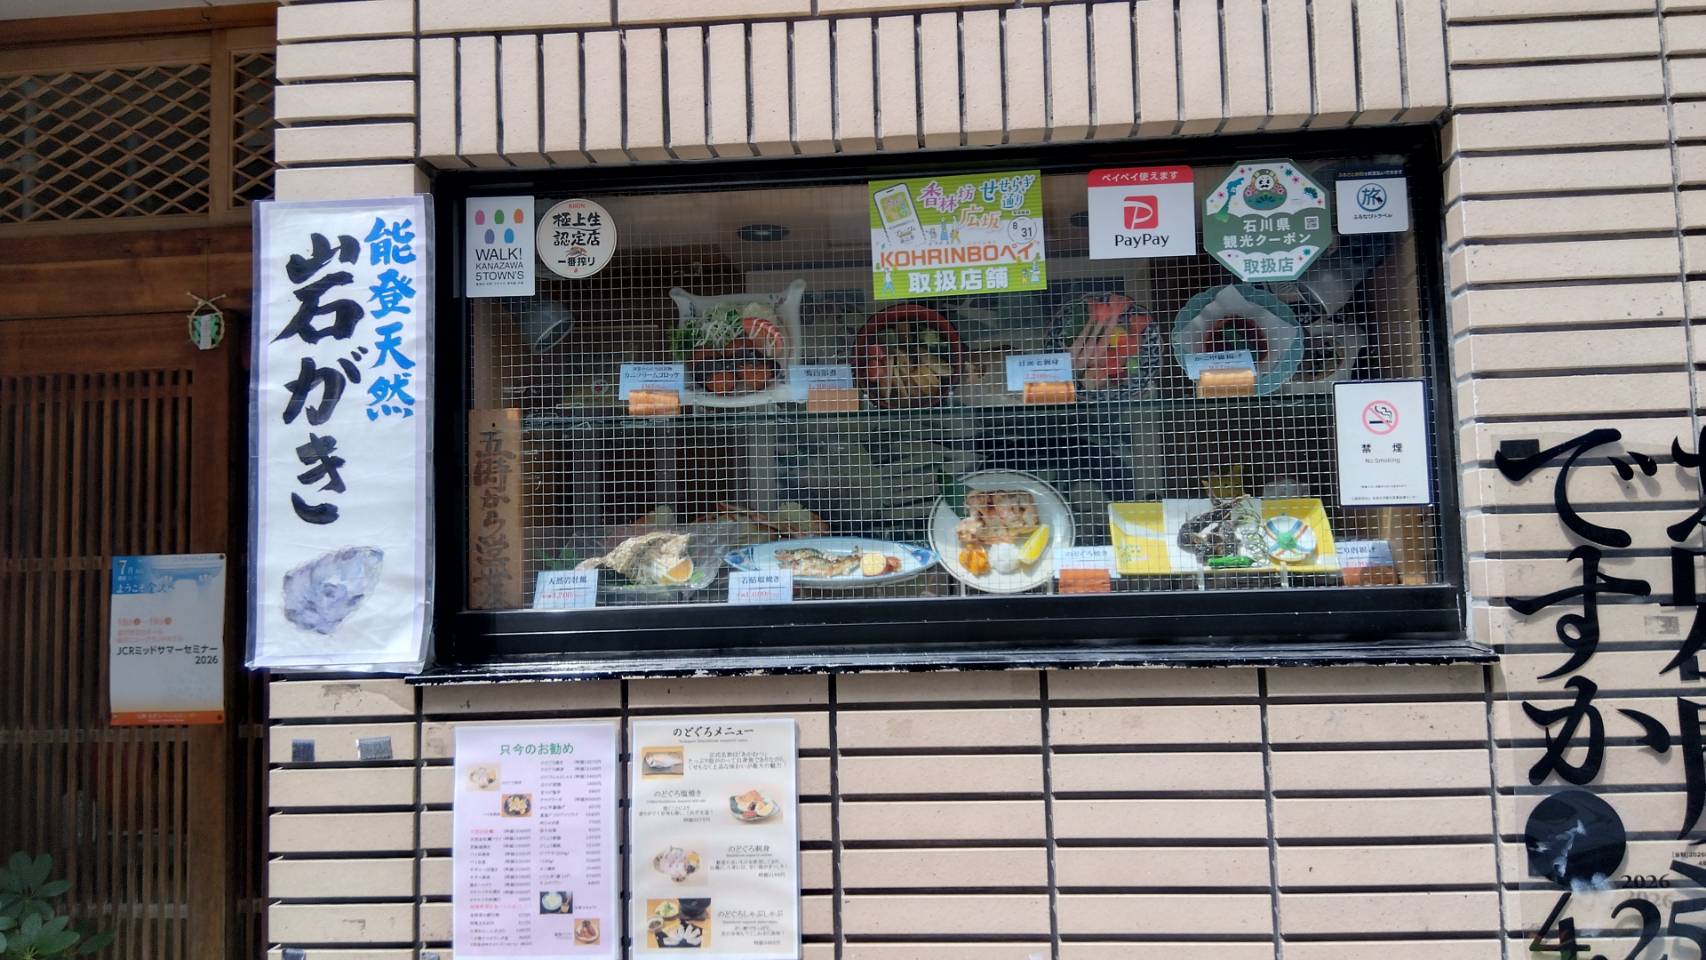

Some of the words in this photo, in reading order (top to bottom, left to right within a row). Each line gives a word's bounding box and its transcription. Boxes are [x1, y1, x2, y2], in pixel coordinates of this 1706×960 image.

[1102, 171, 1178, 182] ペイペイ使えます
[919, 181, 977, 212] 香林坊
[552, 212, 602, 227] 極上生
[960, 205, 1001, 229] 広坂
[1021, 227, 1033, 238] 31
[1243, 217, 1291, 233] 石川県
[553, 230, 601, 246] 認定店
[1114, 233, 1170, 248] PayPay
[1223, 233, 1312, 249] 観光クーポン
[475, 248, 522, 261] WALK!
[558, 256, 596, 267] 一番搾り
[880, 242, 1035, 268] KOHRINBOペイ
[475, 262, 524, 270] KANAZAWA
[1243, 257, 1295, 274] 取扱店
[908, 267, 1009, 292] 取扱店舗
[364, 217, 416, 422] 能登天然
[270, 233, 369, 525] 岩がき
[117, 645, 218, 656] JCRミッドサマーセミナー
[195, 656, 218, 665] 2026
[673, 726, 755, 738] のどぐろメニュー
[500, 743, 574, 756] 只今のお勧め
[1621, 874, 1670, 888] 2026
